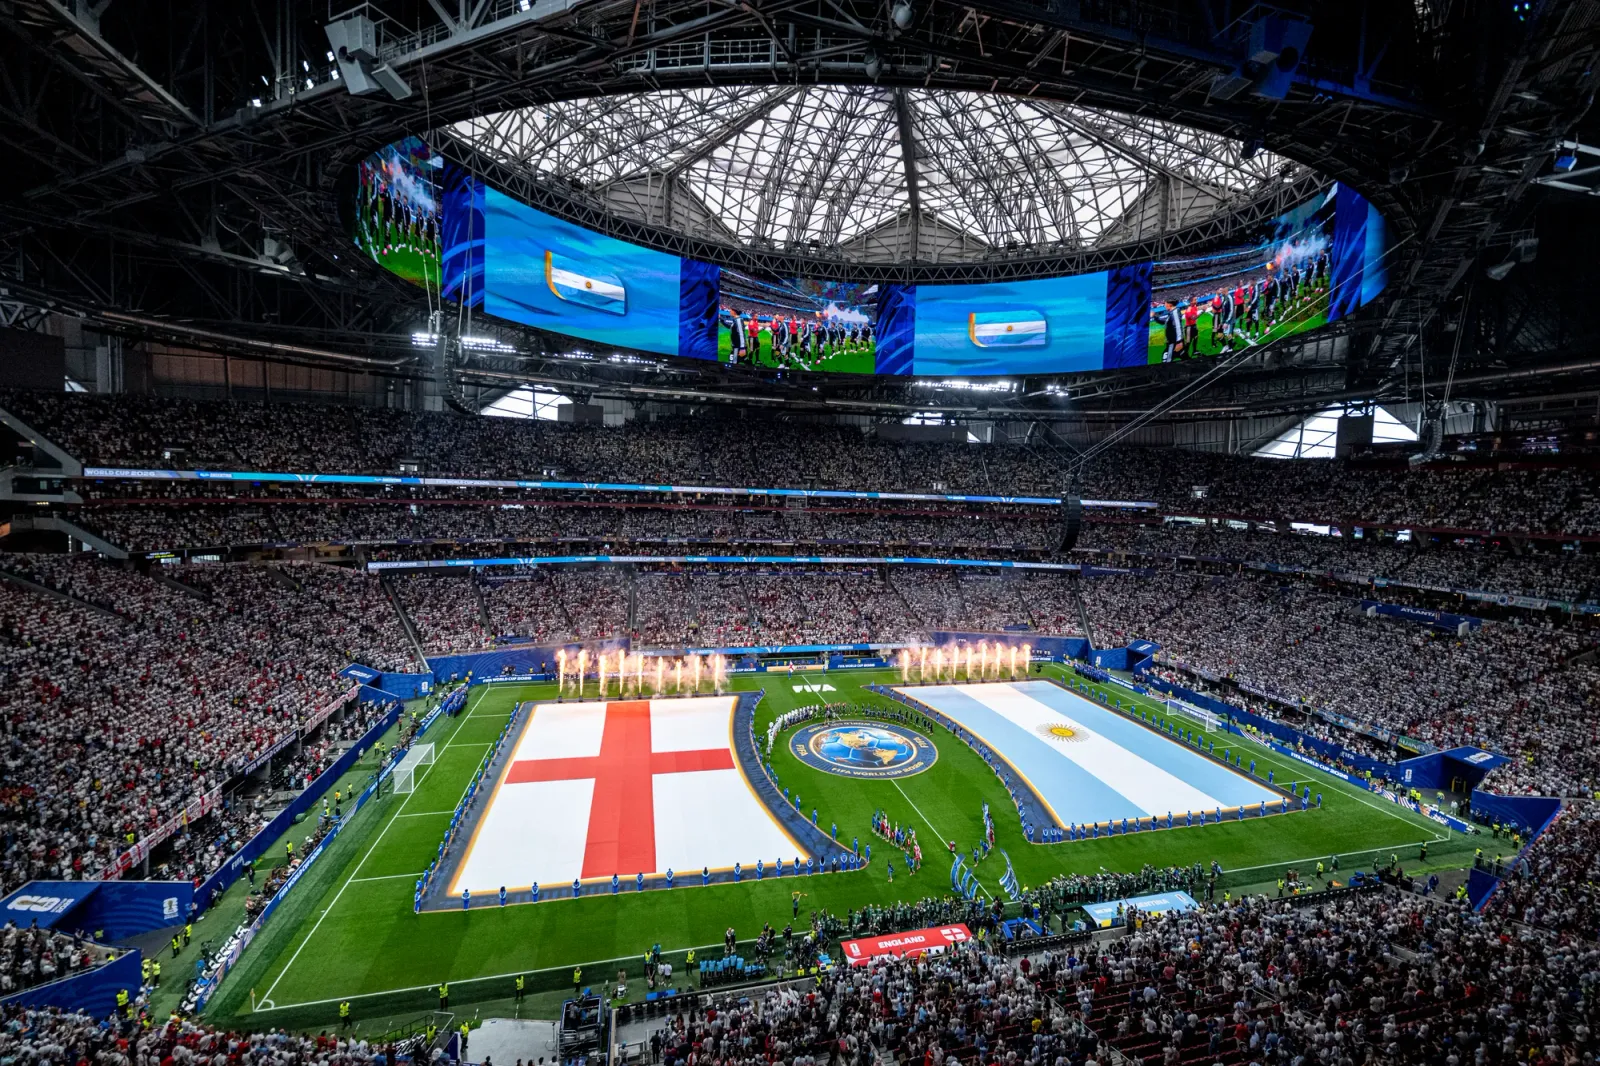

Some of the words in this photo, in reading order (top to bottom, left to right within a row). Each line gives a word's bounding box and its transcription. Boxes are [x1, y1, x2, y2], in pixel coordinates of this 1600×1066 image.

[1250, 686, 1267, 697] WORLD
[912, 736, 929, 748] FIFA
[246, 762, 256, 776] FIFA
[256, 750, 273, 766] WORLD
[273, 744, 282, 754] CUP
[282, 732, 296, 748] 2026
[796, 744, 808, 756] FIFA
[1340, 751, 1354, 760] FIFA
[902, 762, 923, 773] 2026
[1290, 752, 1302, 760] FIFA
[1302, 756, 1319, 768] WORLD
[1319, 764, 1330, 772] CUP
[1330, 768, 1348, 780] 2026
[229, 855, 244, 870] FIFA
[278, 886, 288, 900] FIFA
[288, 868, 302, 889] WORLD
[310, 845, 323, 864] 2026
[878, 936, 925, 948] ENGLAND
